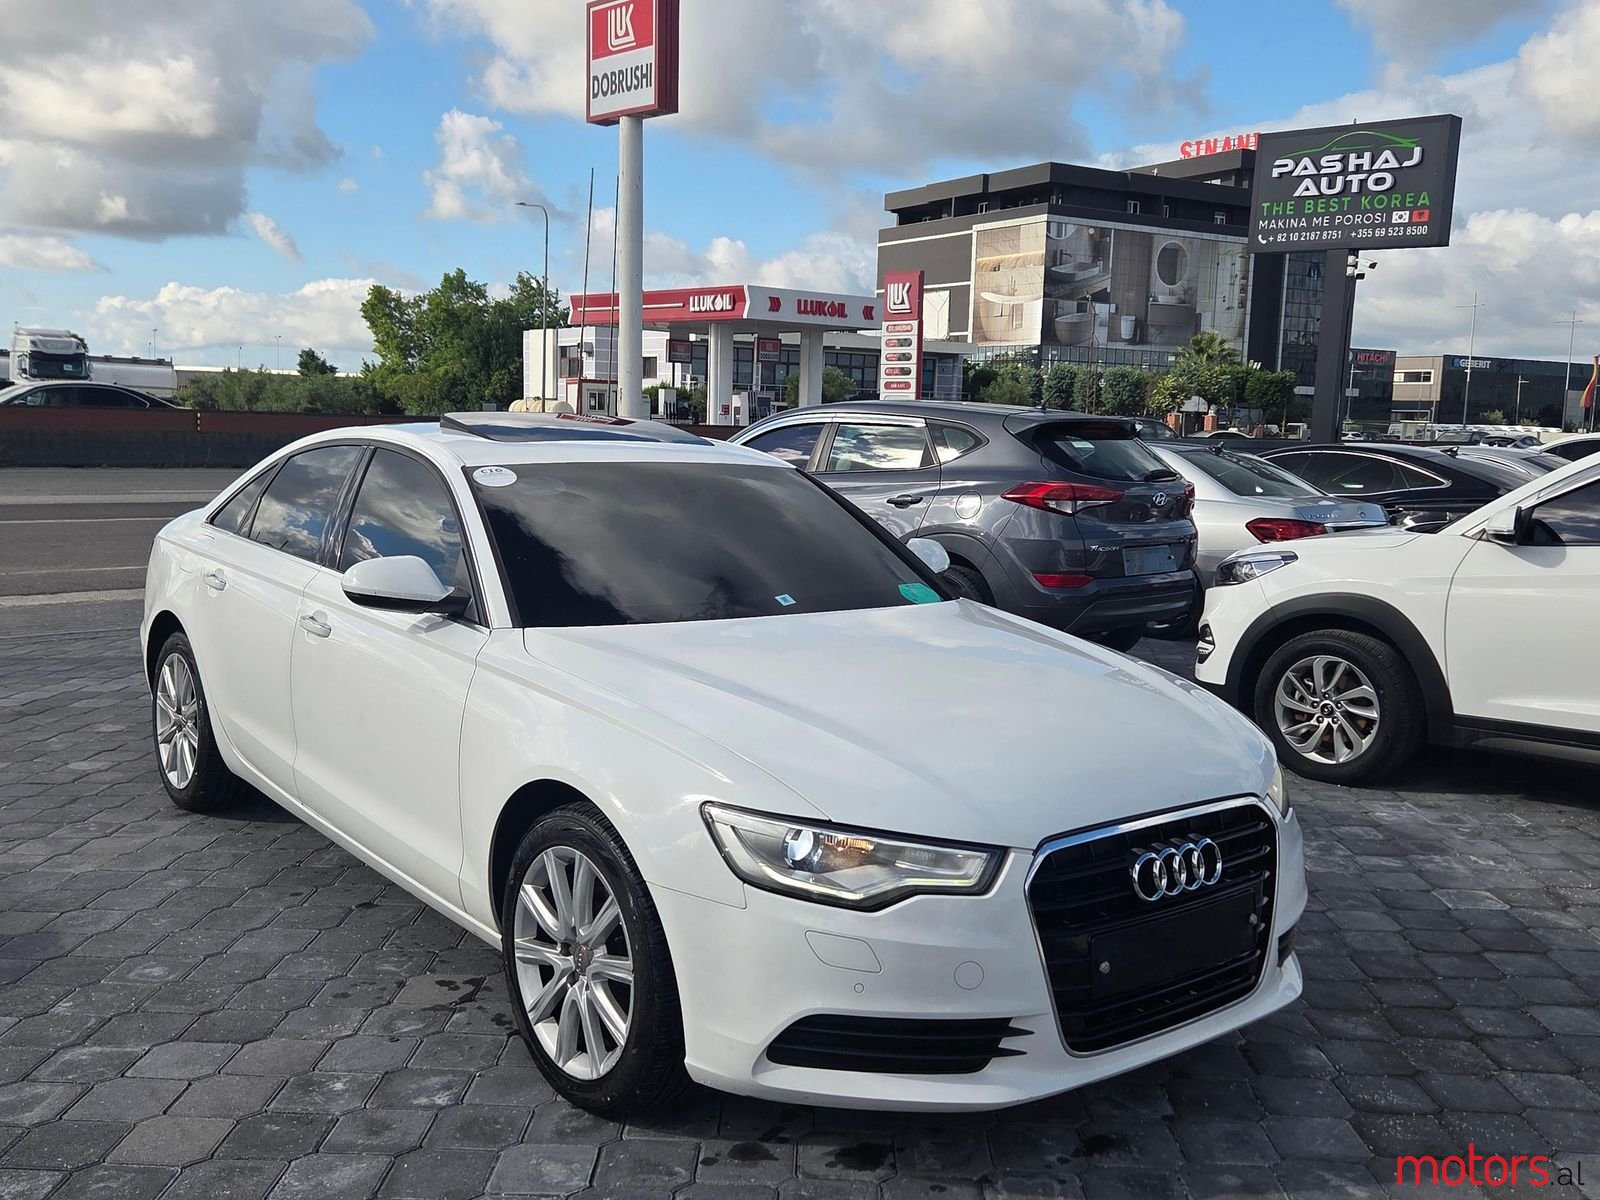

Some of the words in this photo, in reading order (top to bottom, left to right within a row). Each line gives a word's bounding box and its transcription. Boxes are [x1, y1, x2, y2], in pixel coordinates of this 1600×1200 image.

[591, 62, 653, 99] DOBRUSHI
[1271, 146, 1423, 178] PASHAJ
[1293, 172, 1395, 197] AUTO
[1261, 200, 1295, 216] THE
[1304, 197, 1351, 214] BEST
[1361, 191, 1430, 210] KOREA
[1258, 217, 1307, 230] MAKINA
[1312, 215, 1330, 227] ME
[1334, 212, 1386, 226] POROSI
[1289, 232, 1299, 241] 10
[1300, 231, 1320, 241] 2187
[1322, 230, 1342, 240] 8751
[1350, 228, 1373, 238] +355
[1374, 227, 1386, 237] 69
[1387, 226, 1404, 237] 523
[1406, 225, 1428, 235] 8500
[1356, 352, 1388, 363] HITACHI
